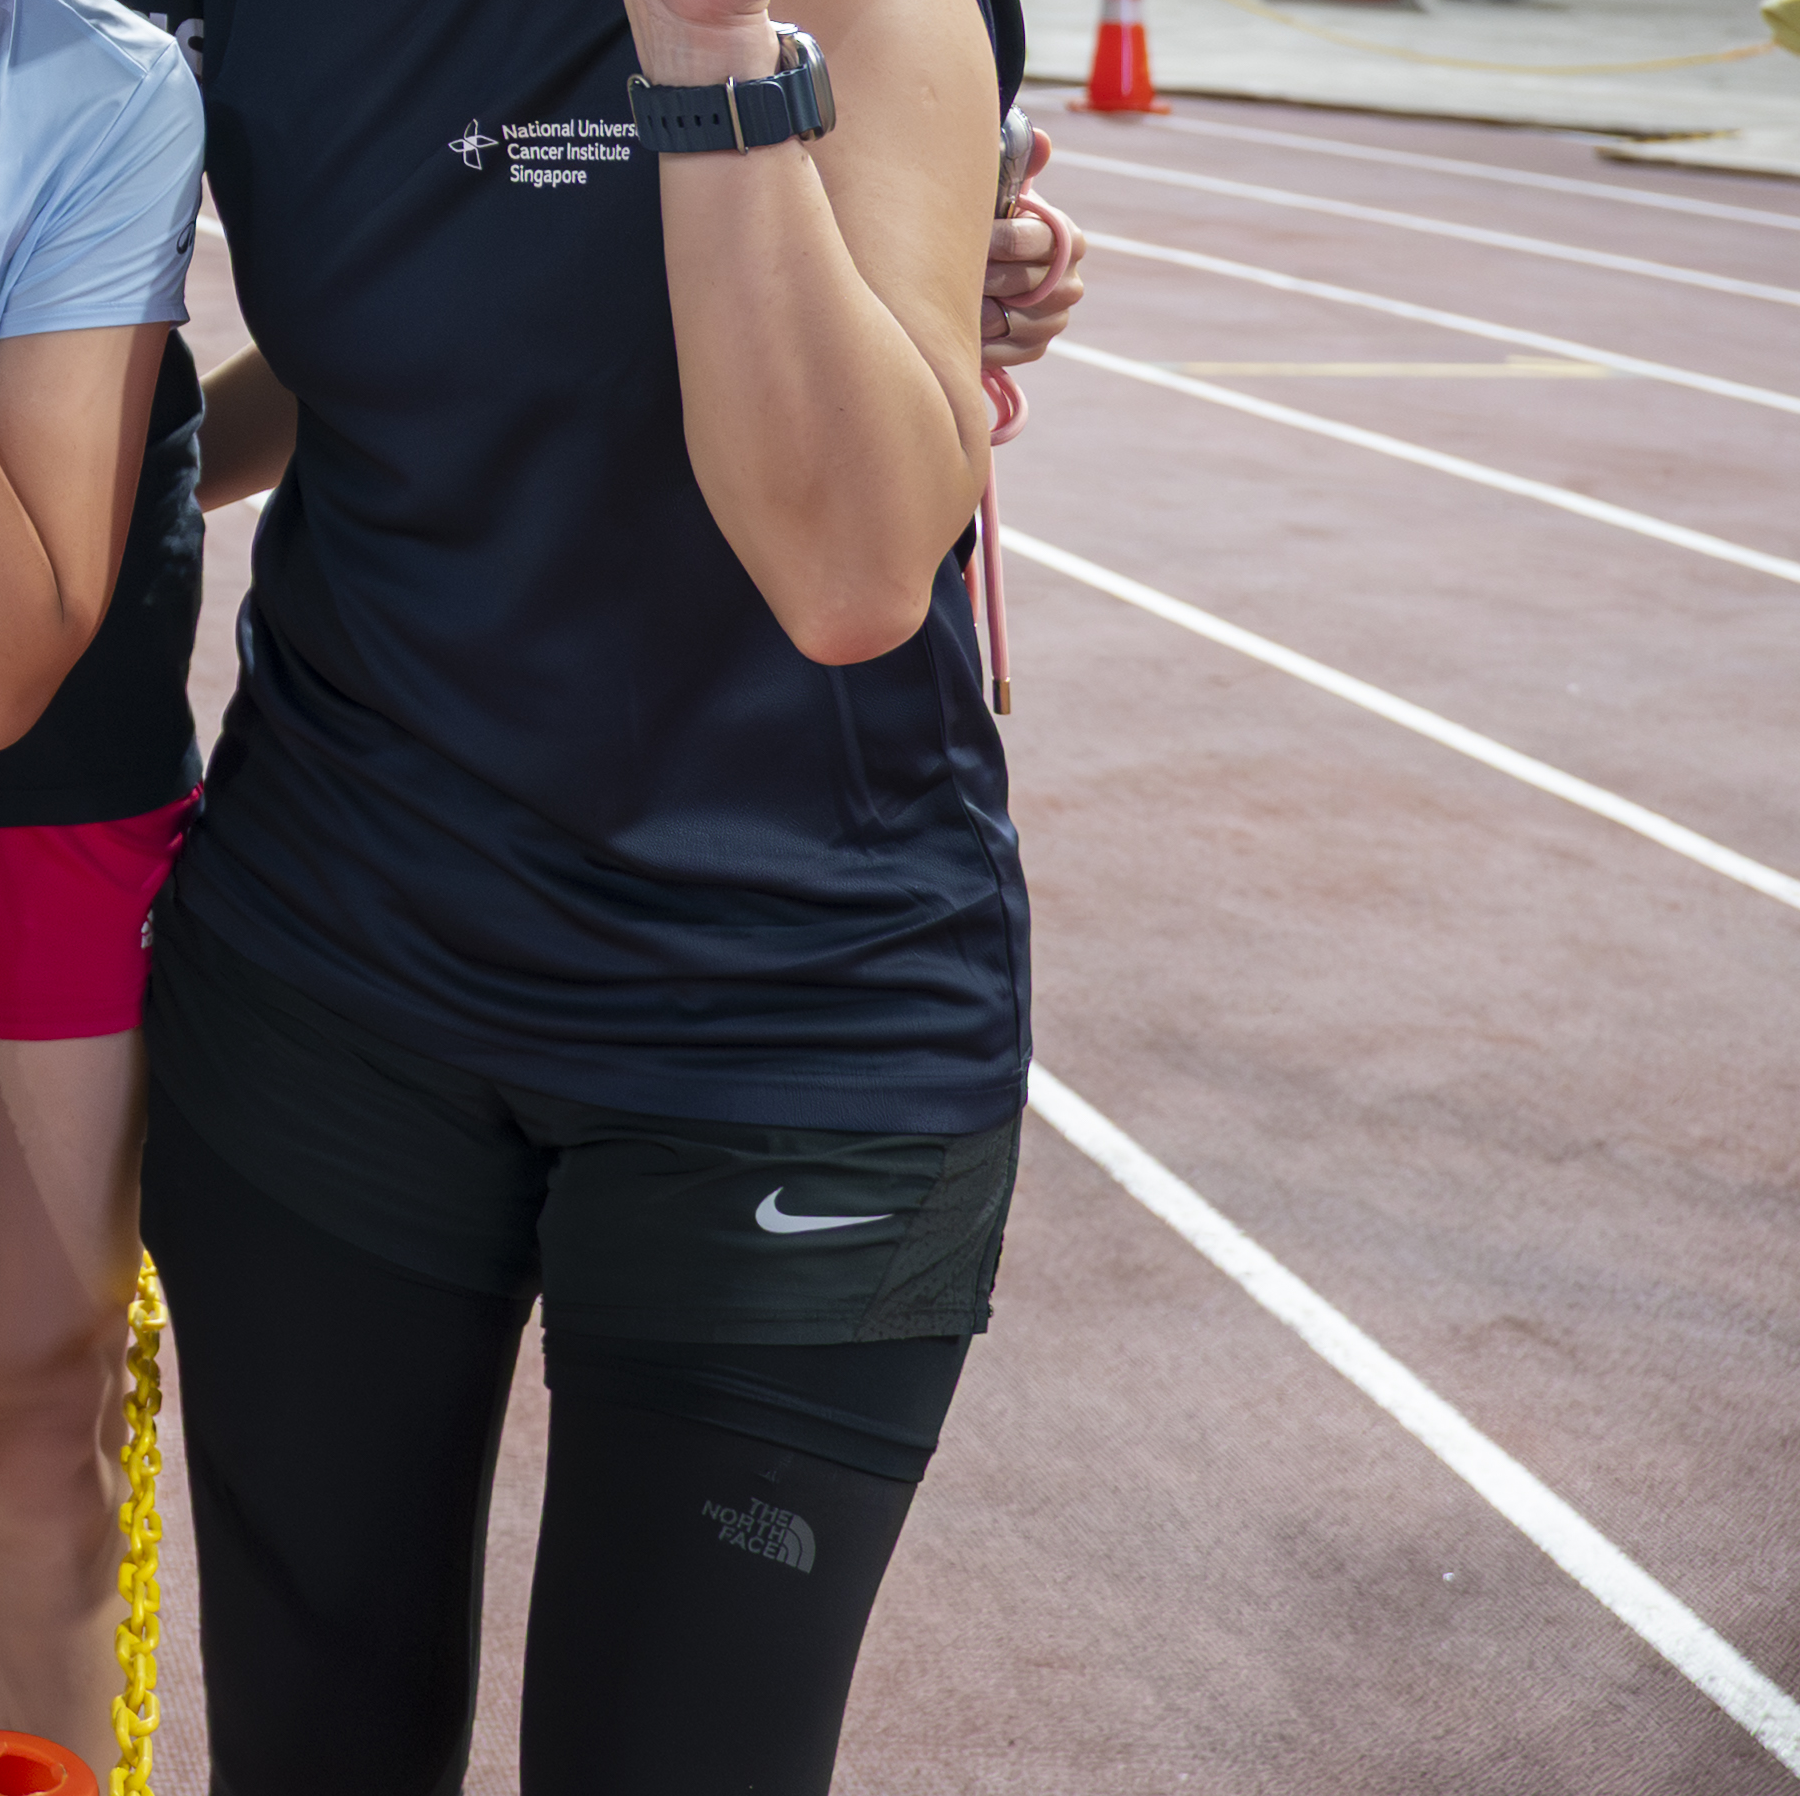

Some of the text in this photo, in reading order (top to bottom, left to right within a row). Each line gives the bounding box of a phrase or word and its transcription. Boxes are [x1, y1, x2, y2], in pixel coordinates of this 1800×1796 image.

[502, 119, 574, 140] National
[507, 143, 631, 161] Cancer Institute
[510, 164, 587, 188] Singapore
[701, 1499, 787, 1544] NORTH
[750, 1496, 794, 1528] THE
[718, 1525, 779, 1560] FACE
